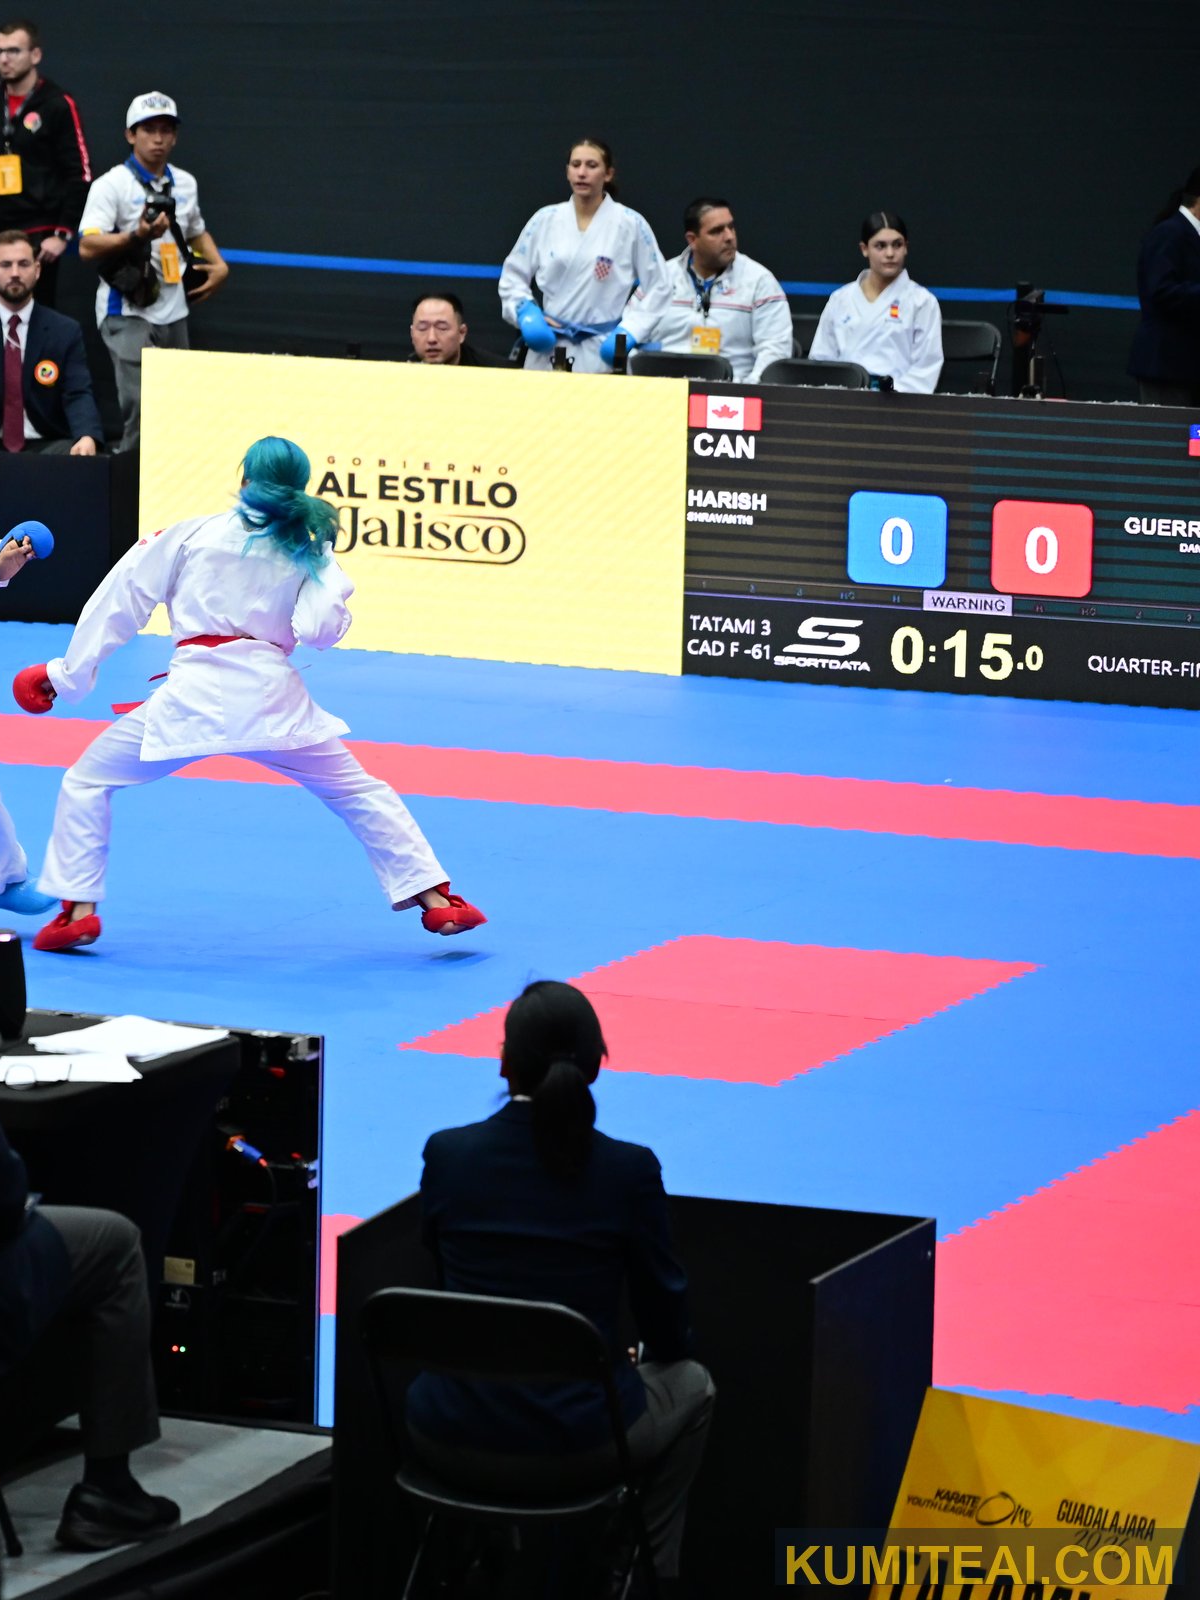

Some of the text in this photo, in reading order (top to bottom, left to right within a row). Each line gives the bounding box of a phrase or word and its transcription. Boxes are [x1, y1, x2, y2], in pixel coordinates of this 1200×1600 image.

[693, 432, 755, 459] CAN
[327, 455, 508, 476] GOBIERNO
[315, 471, 518, 508] AL ESTILO
[687, 489, 767, 511] HARISH
[333, 505, 511, 555] Jalisco
[1124, 516, 1200, 538] GUERR
[880, 516, 915, 565] 0
[1025, 526, 1059, 574] 0
[931, 596, 1006, 612] WARNING
[689, 614, 772, 636] TATAMI 3
[686, 639, 771, 660] CAD F -61
[773, 655, 871, 672] SPORTDATA
[935, 1489, 980, 1508] KARATE
[1056, 1499, 1156, 1542] GUADALAJARA
